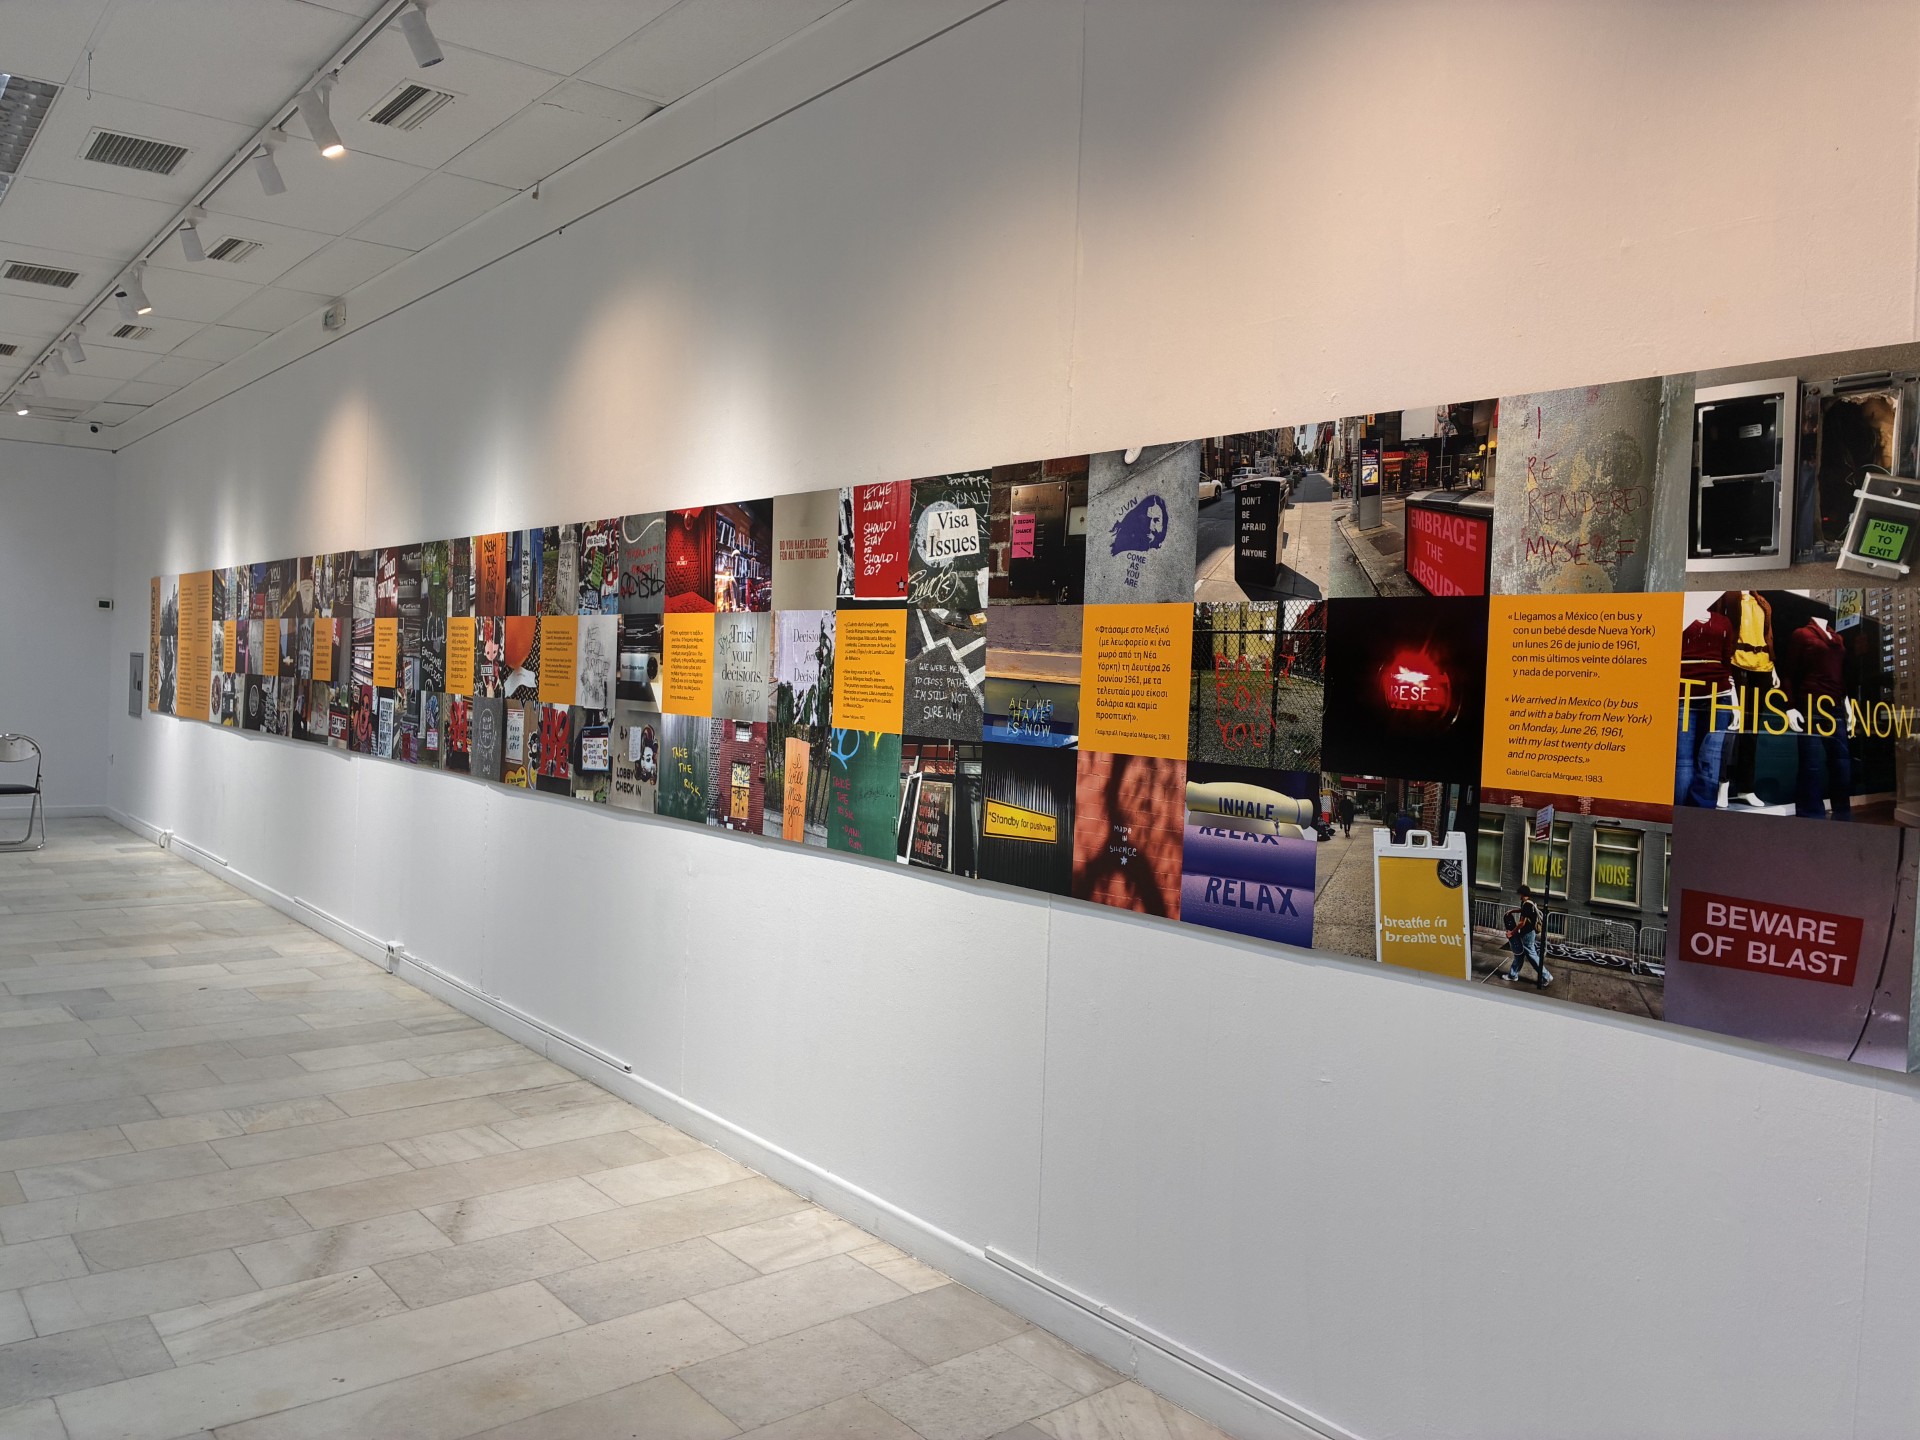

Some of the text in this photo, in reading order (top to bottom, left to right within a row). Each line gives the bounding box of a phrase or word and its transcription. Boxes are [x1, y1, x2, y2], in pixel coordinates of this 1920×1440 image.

[864, 481, 892, 500] LET ME
[1242, 497, 1261, 506] DON'T
[938, 510, 969, 530] Visa
[1242, 511, 1249, 519] BE
[864, 521, 896, 534] SHOULD I
[1242, 523, 1266, 531] AFRAID
[1412, 510, 1477, 551] EMBRACE
[1873, 522, 1903, 534] PUSH
[719, 520, 757, 556] TRAVEL
[780, 539, 808, 550] DO YOU A
[864, 533, 884, 546] STAY
[1878, 535, 1892, 545] TO
[929, 535, 976, 558] Issues
[1426, 541, 1443, 563] THE
[1526, 536, 1635, 567] MYSELF
[1869, 546, 1892, 557] EXIT
[864, 552, 898, 564] SHOULD I
[1127, 553, 1146, 564] COME
[1242, 549, 1267, 558] ANYONE
[864, 564, 881, 576] GO?
[1130, 561, 1139, 570] AS
[1126, 569, 1139, 579] YOU
[1124, 578, 1138, 588] ARE
[1566, 612, 1598, 620] México
[1601, 611, 1615, 622] (en
[1618, 612, 1634, 620] bus
[730, 625, 755, 643] Trust
[1544, 626, 1566, 634] bebé
[1568, 626, 1596, 634] desde
[1599, 626, 1628, 635] Nueva
[1630, 626, 1655, 637] York)
[1525, 640, 1548, 648] lunes
[1550, 640, 1562, 648] 26
[1565, 640, 1576, 649] de
[1577, 641, 1600, 651] junio
[1602, 641, 1614, 649] de
[733, 650, 752, 663] your
[1547, 654, 1579, 663] últimos
[1582, 655, 1609, 664] veinte
[1612, 655, 1647, 664] dólares
[722, 663, 762, 683] decisions.
[919, 663, 929, 671] WE
[930, 664, 946, 672] WERE
[1162, 664, 1170, 672] 26
[1513, 668, 1553, 677] y nada de
[923, 678, 943, 687] CROSS
[951, 693, 967, 704] NOT
[1009, 698, 1051, 712] ALL WE
[1527, 696, 1638, 709] arrived in Mexico (by bus
[923, 706, 963, 723] SURE WHY
[1680, 679, 1912, 738] THIS IS NOW
[1013, 711, 1045, 723] HAVE
[1510, 709, 1526, 717] and
[1528, 710, 1546, 718] with
[1555, 711, 1577, 721] baby
[1579, 713, 1600, 722] from
[1602, 713, 1624, 722] New
[1627, 714, 1652, 726] York)
[1007, 722, 1050, 737] IS NOW
[1522, 723, 1558, 734] Monday,
[1560, 725, 1581, 734] June
[1583, 726, 1598, 736] 26,
[1509, 737, 1625, 752] with my last twenty dollars
[672, 747, 688, 759] TAKE
[1508, 750, 1524, 759] and
[617, 767, 635, 779] LOBBY
[679, 762, 692, 773] THE
[1507, 768, 1583, 782] Gabriel García Márquez,
[616, 781, 641, 796] CHECK IN
[684, 779, 701, 796] RISK
[921, 790, 940, 804] KNOW
[1219, 797, 1274, 820] INHALE
[917, 820, 939, 836] KNOW
[1021, 818, 1029, 828] for
[1533, 855, 1563, 878] MAKE
[1205, 877, 1299, 917] RELAX
[1384, 916, 1447, 929] breathe in
[1707, 902, 1837, 945] BEWARE
[1386, 931, 1461, 946] breathe out
[1690, 933, 1847, 976] OF BLAST
